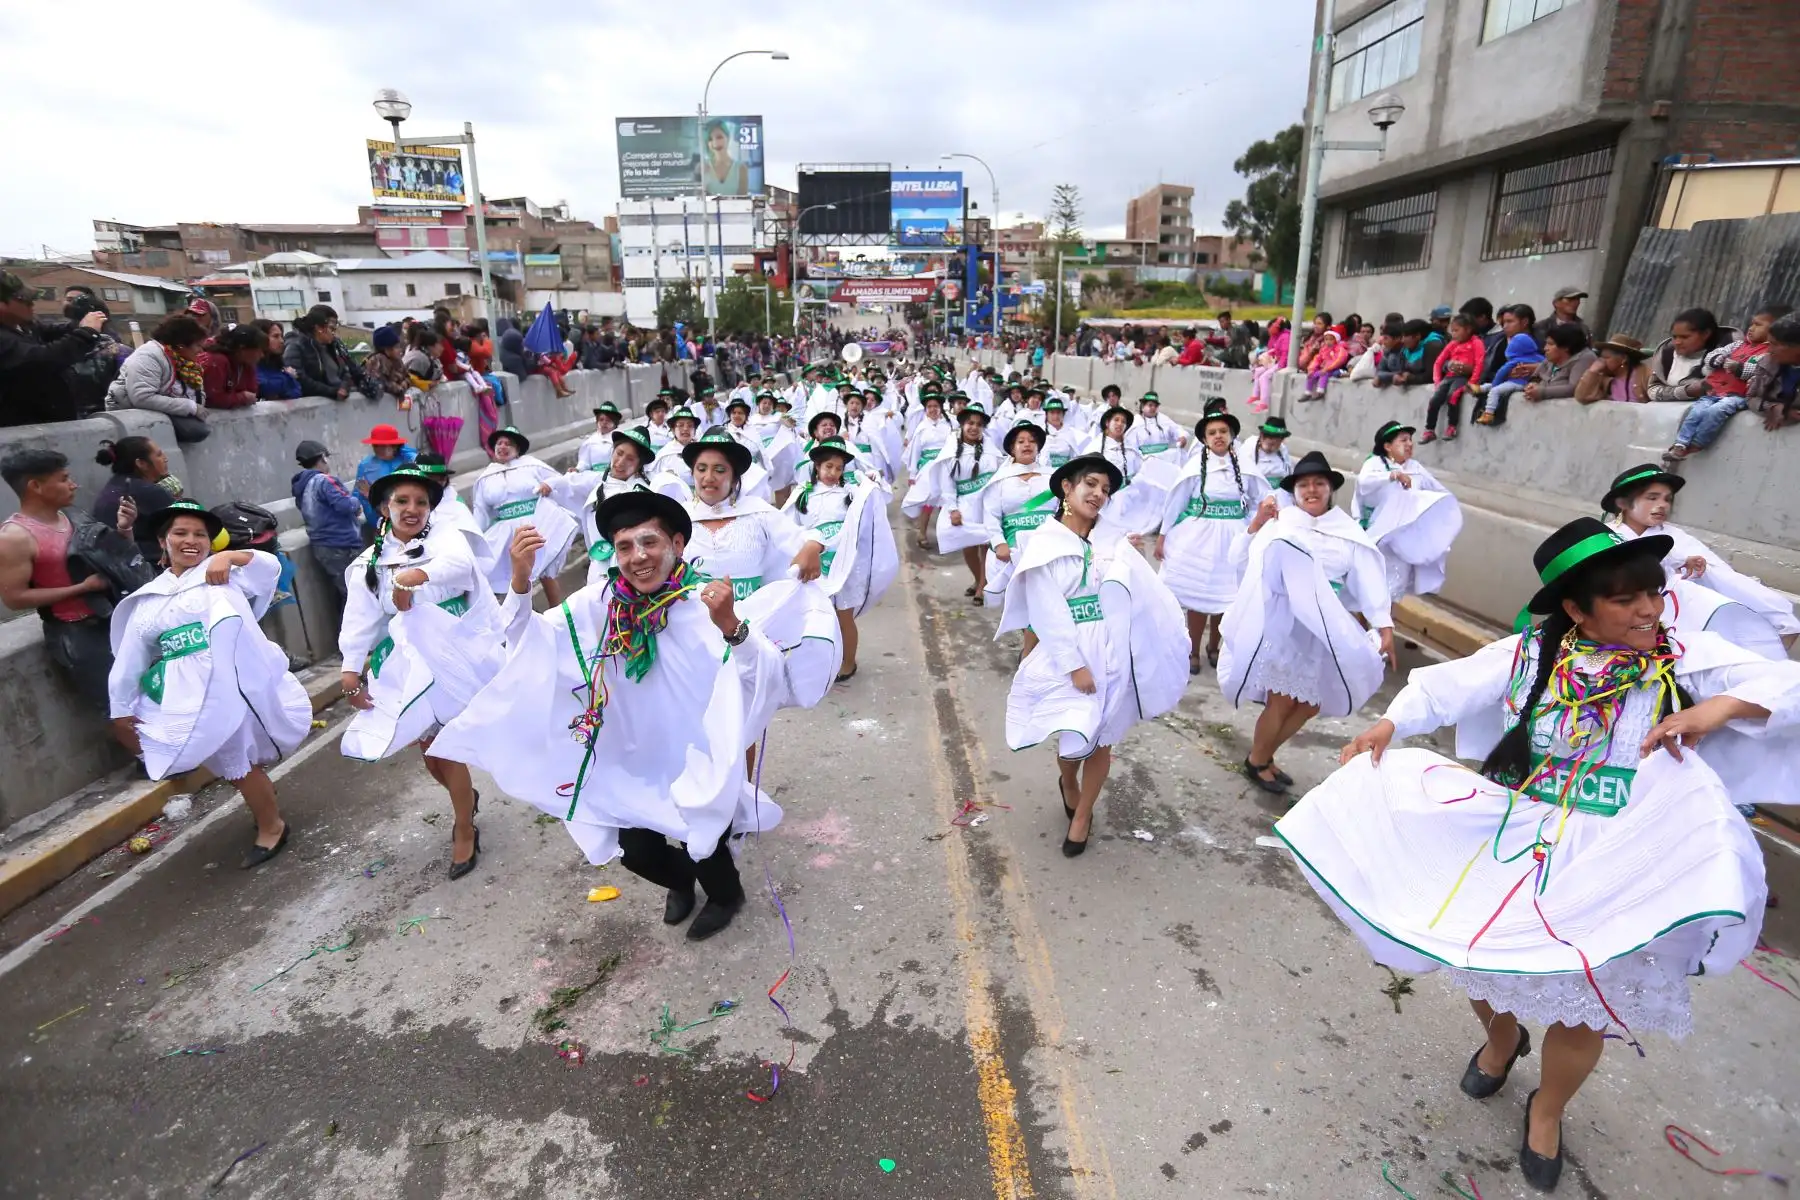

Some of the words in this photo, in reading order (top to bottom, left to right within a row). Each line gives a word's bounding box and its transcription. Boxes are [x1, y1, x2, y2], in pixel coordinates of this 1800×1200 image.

[740, 127, 758, 144] 31
[892, 181, 923, 191] ENTEL
[924, 181, 958, 191] LLEGA
[841, 287, 883, 296] LLAMADAS
[884, 287, 928, 296] ILIMITADAS
